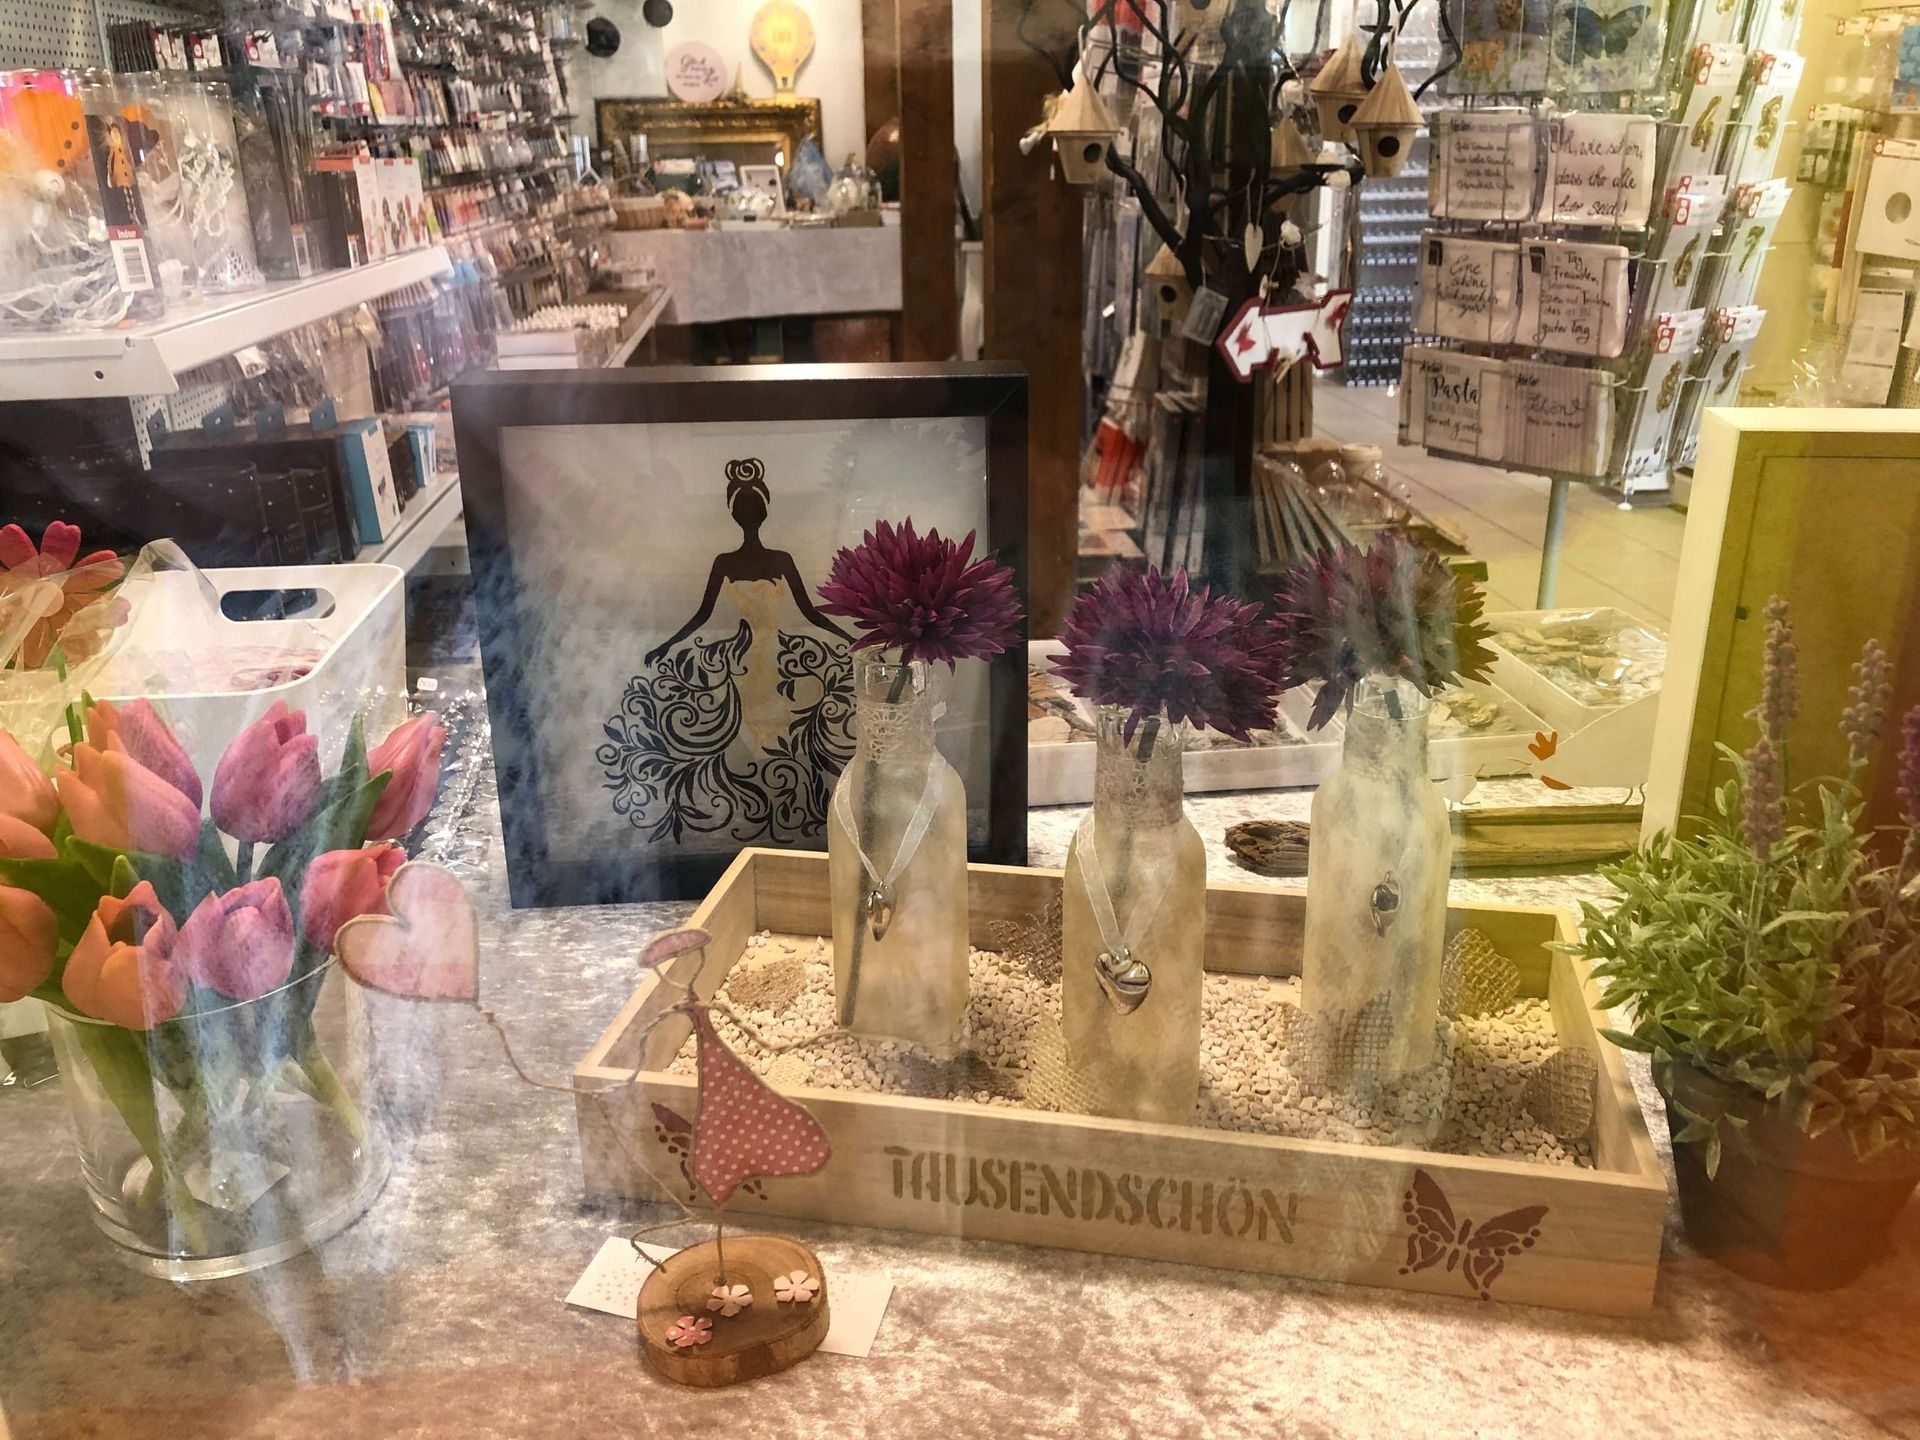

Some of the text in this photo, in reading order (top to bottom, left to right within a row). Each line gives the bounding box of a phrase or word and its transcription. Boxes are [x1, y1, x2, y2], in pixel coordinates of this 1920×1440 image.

[1555, 167, 1582, 187] dass
[116, 228, 138, 239] Indoor
[1431, 376, 1480, 405] Pasta
[882, 1145, 1299, 1245] TAUSENDSCHÖN
